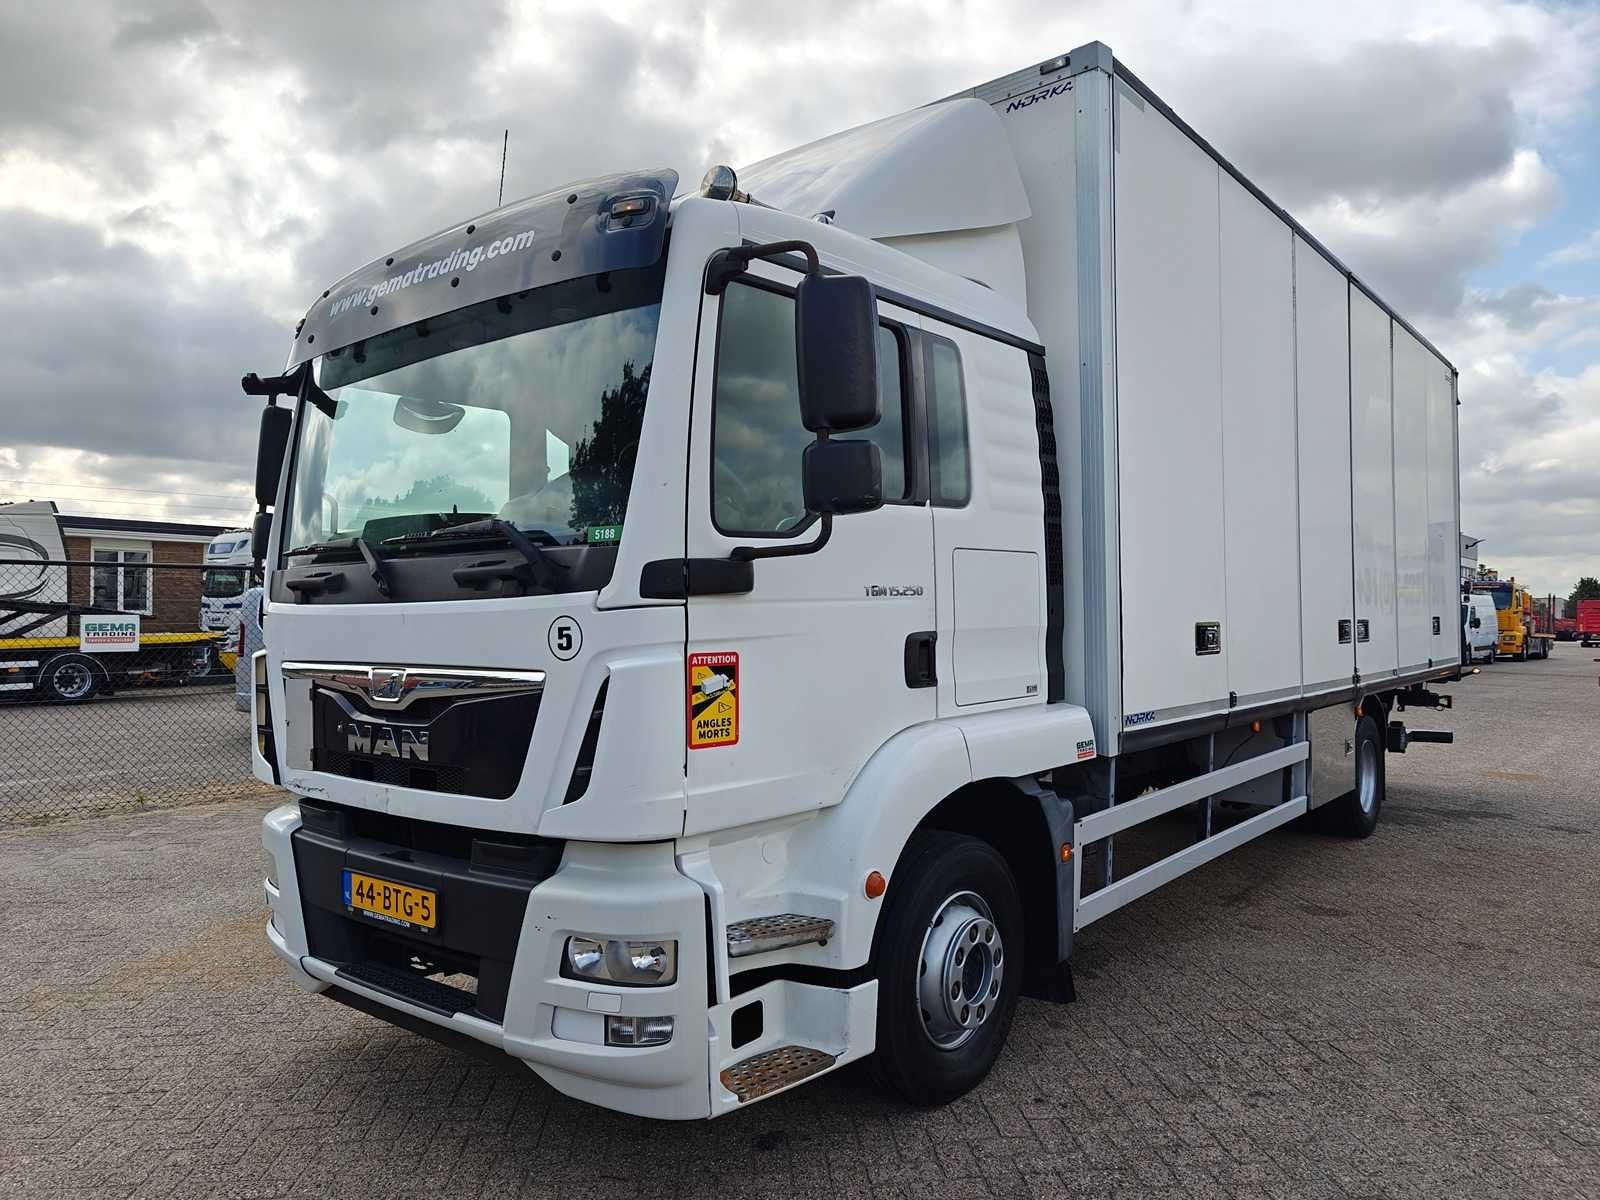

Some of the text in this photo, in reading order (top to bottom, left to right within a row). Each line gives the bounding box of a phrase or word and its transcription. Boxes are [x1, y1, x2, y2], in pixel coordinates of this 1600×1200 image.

[1006, 81, 1074, 113] NORKA
[329, 230, 535, 317] www.gematrading.com
[888, 586, 923, 597] 15.250
[85, 623, 136, 631] GEMA
[557, 626, 573, 651] 5
[692, 655, 737, 665] ATTENTION
[696, 718, 732, 730] ANGLES
[347, 723, 429, 761] MAN
[698, 728, 731, 740] MORTS
[355, 879, 431, 921] 44-BTG-5
